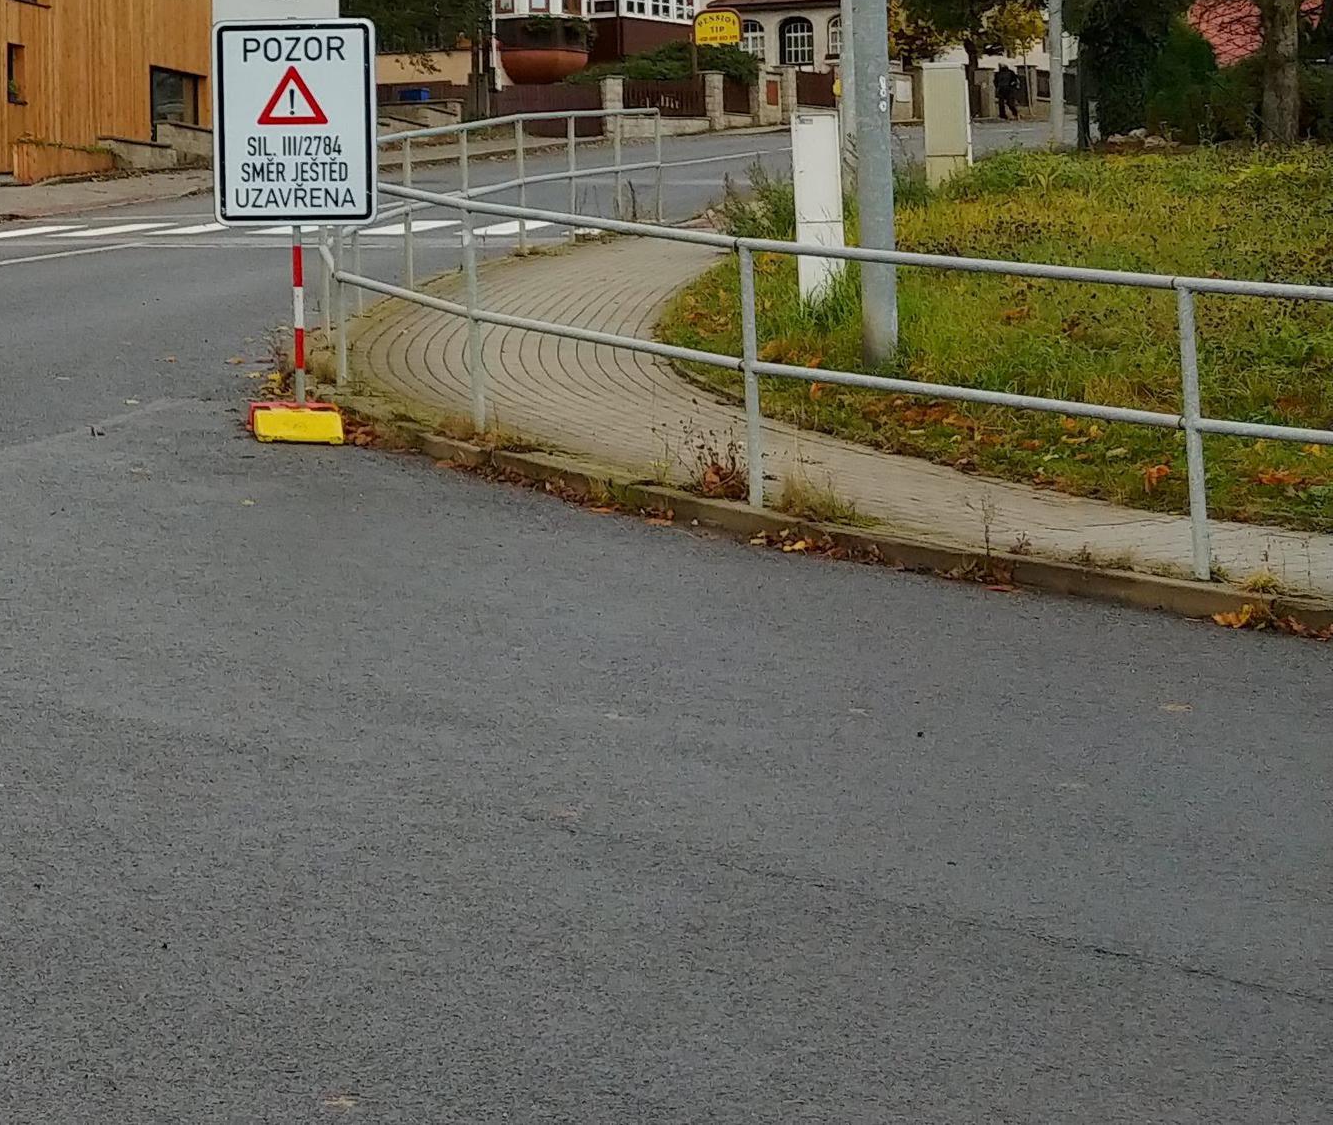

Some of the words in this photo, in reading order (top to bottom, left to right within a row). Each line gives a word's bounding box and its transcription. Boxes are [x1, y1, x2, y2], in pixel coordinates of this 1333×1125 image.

[709, 25, 725, 34] TIP
[242, 35, 346, 63] POZOR
[247, 136, 277, 157] SIL.
[282, 135, 343, 157] III/2784
[241, 157, 286, 183] SMĚR
[290, 156, 349, 183] JEŠTĚD
[235, 182, 357, 209] UZAVŘENA
